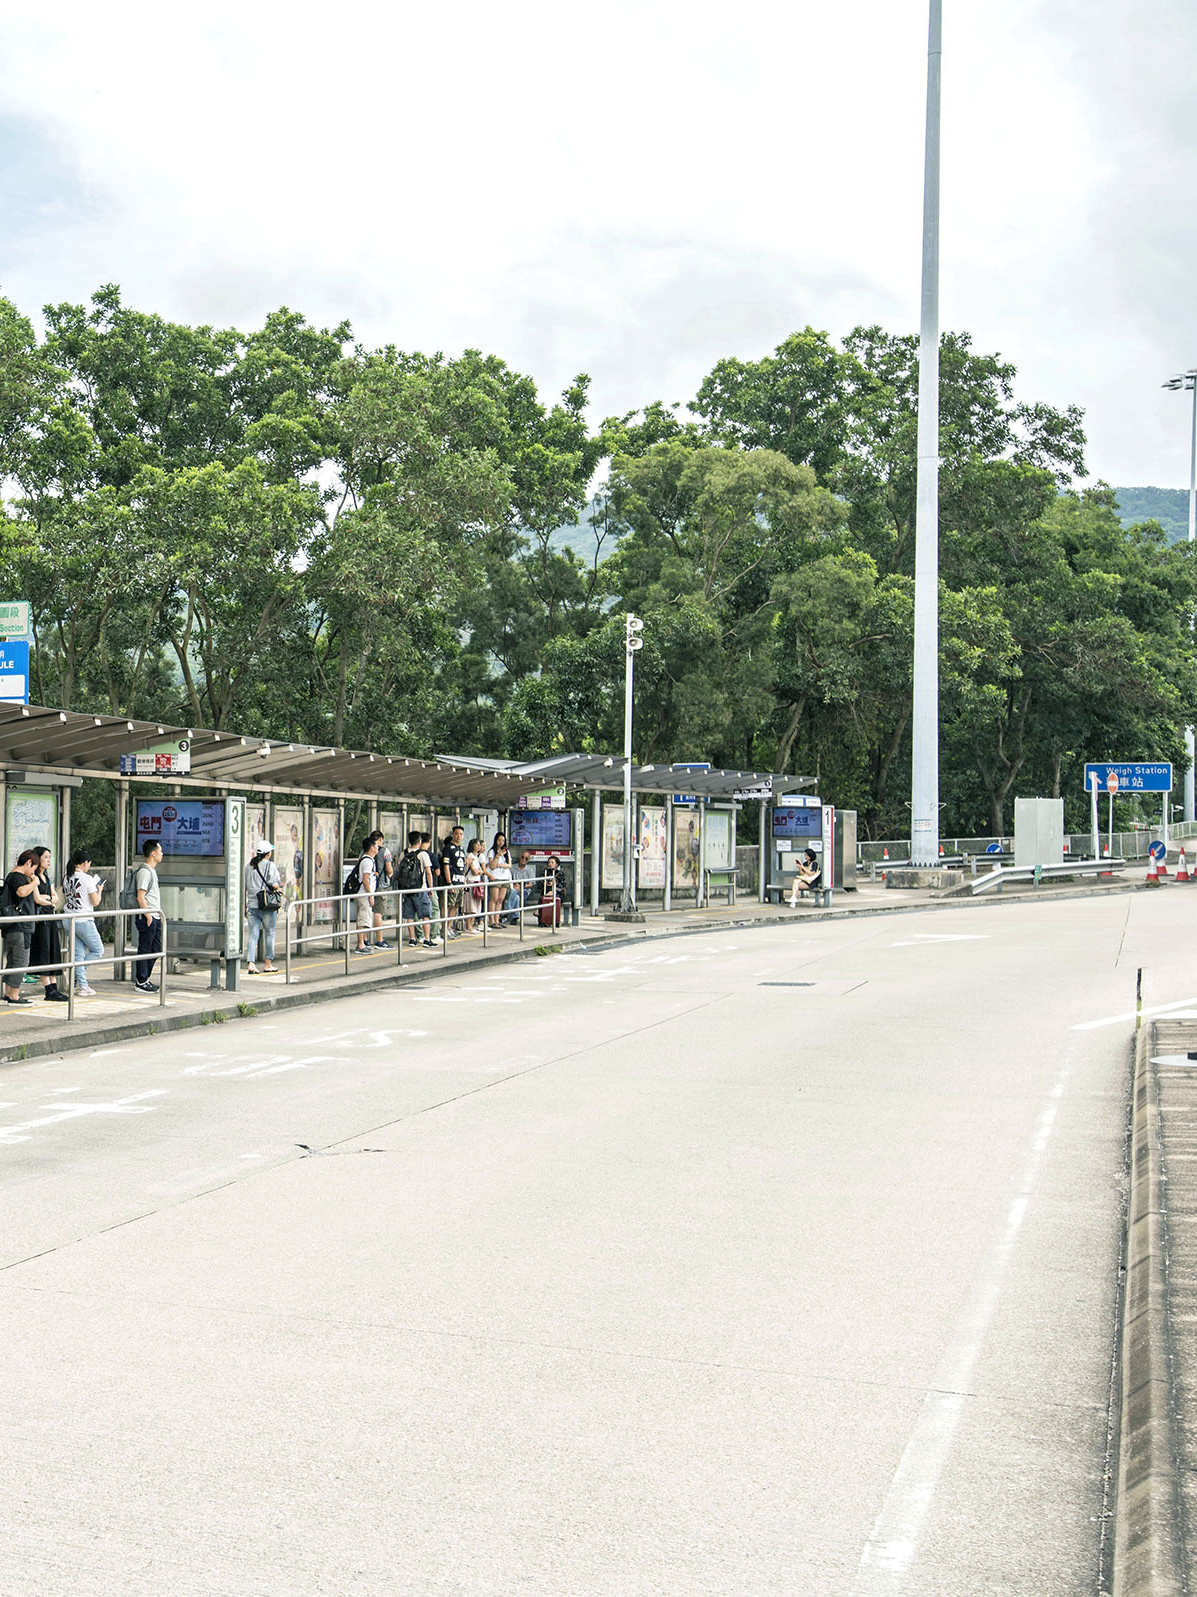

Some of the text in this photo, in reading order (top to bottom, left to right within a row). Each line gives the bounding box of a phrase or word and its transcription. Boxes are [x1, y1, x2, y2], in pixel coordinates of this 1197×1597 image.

[0, 623, 24, 633] Section
[180, 741, 187, 751] 3
[1106, 767, 1132, 775] Weigh
[139, 816, 162, 830] 屯門
[177, 816, 200, 831] 大埔
[231, 805, 239, 835] 3
[825, 810, 830, 825] 1
